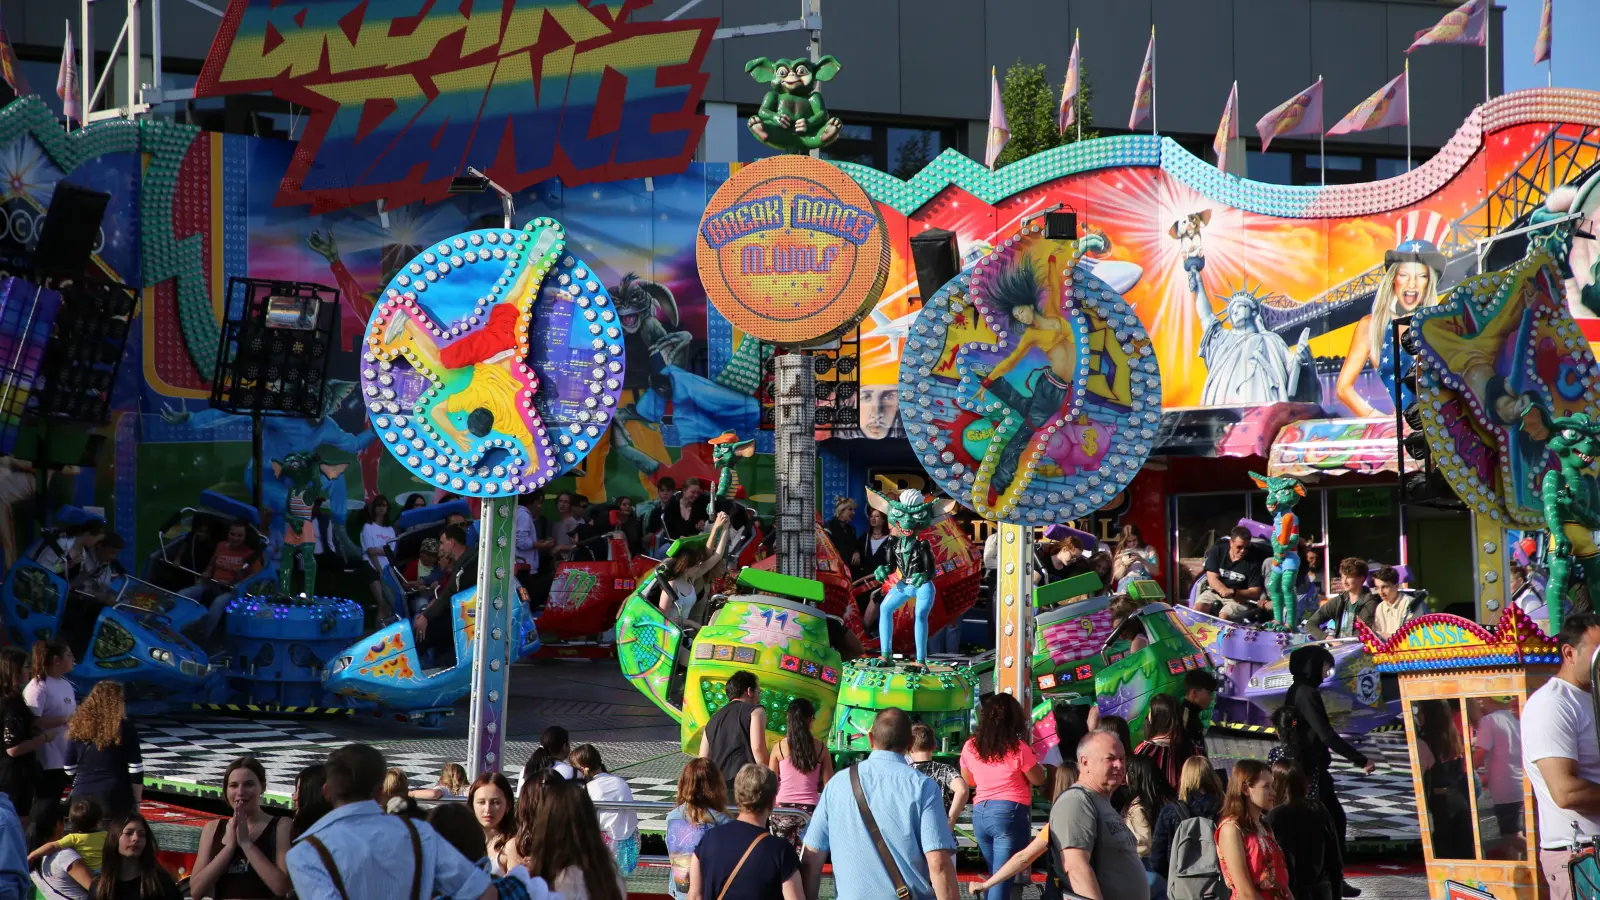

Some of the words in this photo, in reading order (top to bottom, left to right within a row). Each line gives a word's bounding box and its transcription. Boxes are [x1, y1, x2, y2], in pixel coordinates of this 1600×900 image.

[300, 28, 703, 191] DANCE
[704, 196, 783, 247] BREAK
[794, 196, 875, 242] DANCE
[759, 608, 789, 631] 11
[1080, 618, 1094, 637] 9
[1197, 626, 1213, 642] 5
[1407, 621, 1470, 648] KASSE
